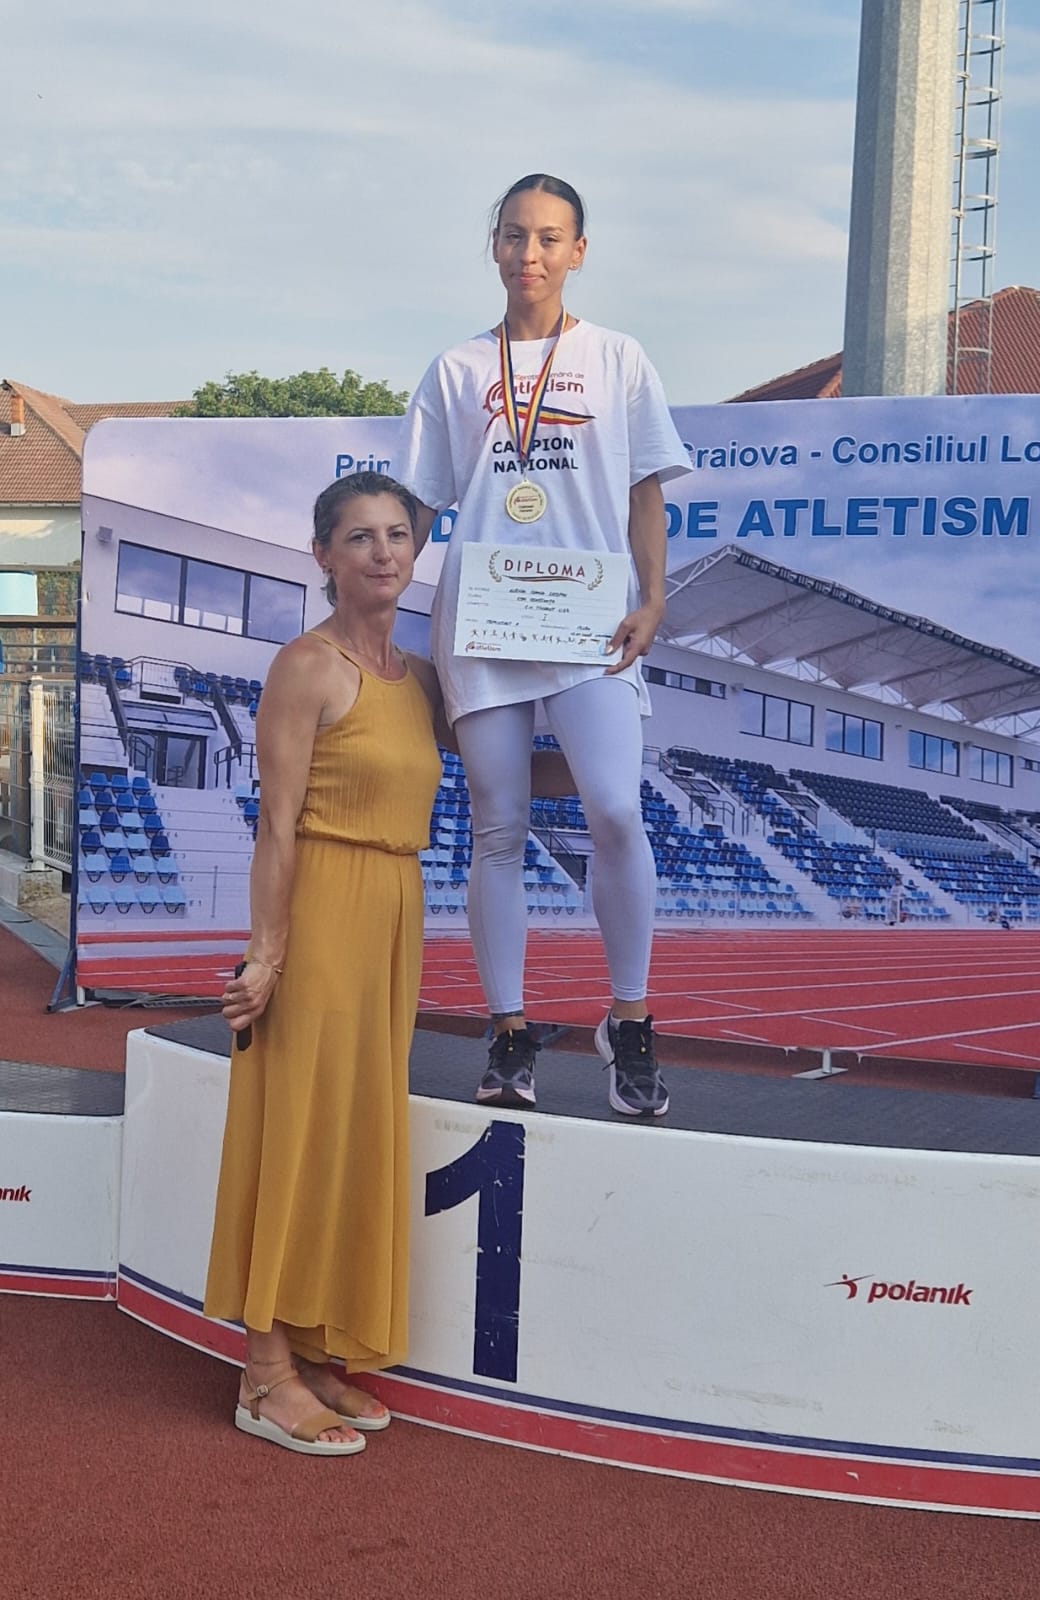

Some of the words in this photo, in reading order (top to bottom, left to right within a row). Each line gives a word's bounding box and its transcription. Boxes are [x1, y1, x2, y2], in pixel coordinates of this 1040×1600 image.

[492, 437, 574, 454] CAPION
[832, 435, 988, 464] Consiliul
[736, 497, 1030, 537] ATLETISM
[504, 559, 586, 577] DIPLOMA
[0, 1185, 32, 1202] nik
[425, 1120, 526, 1383] 1
[867, 1280, 974, 1305] polanik
